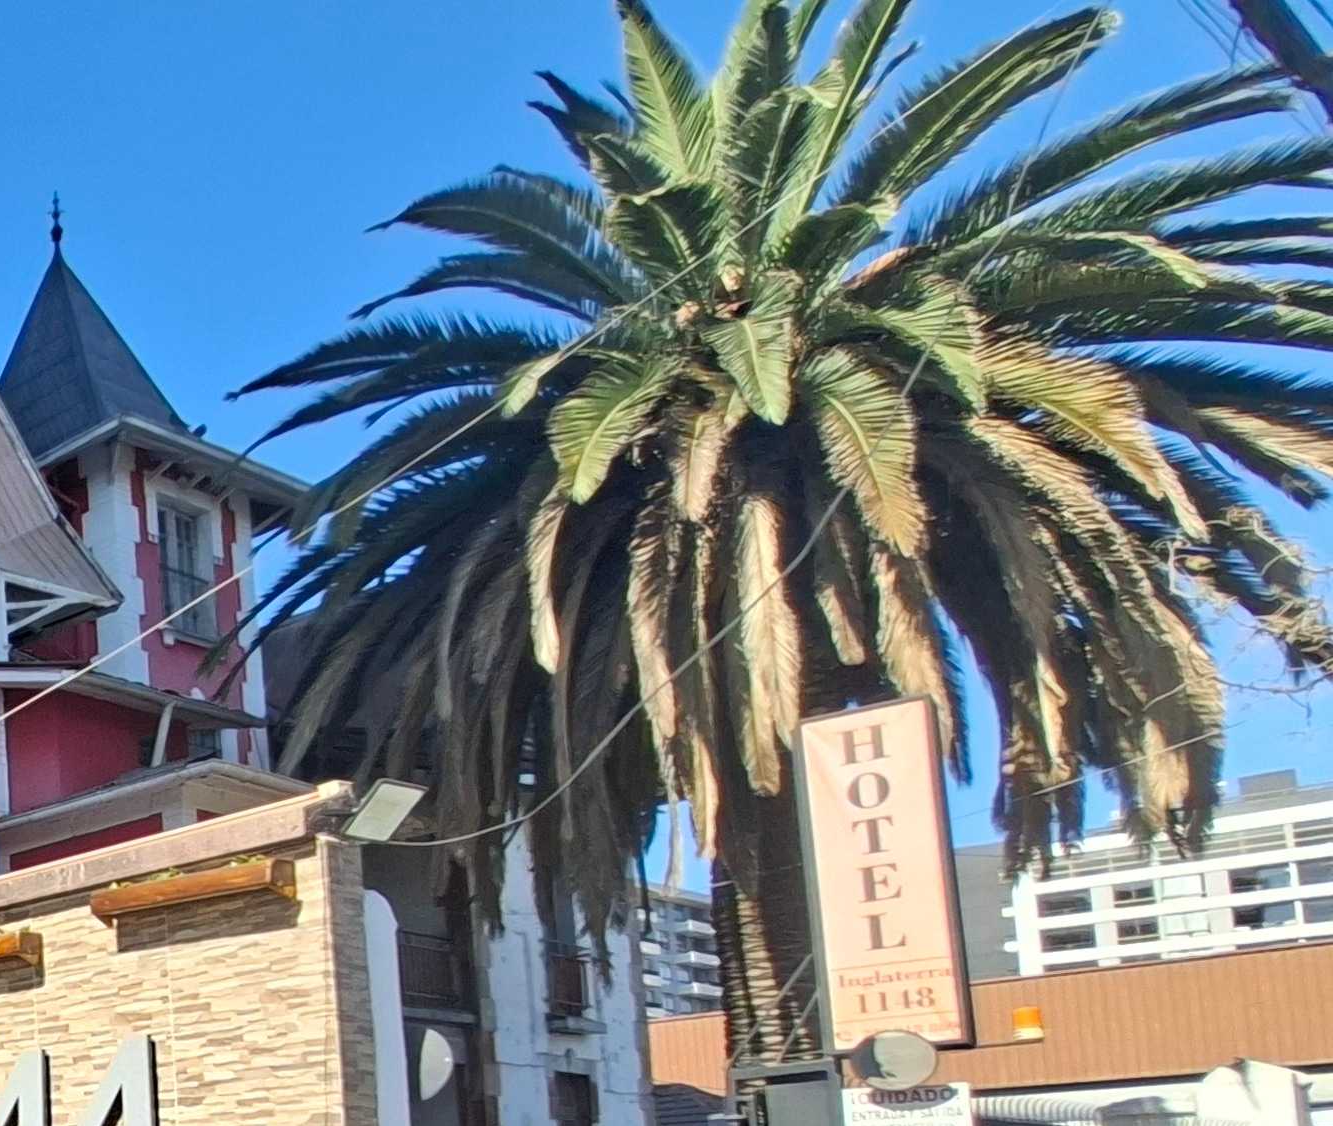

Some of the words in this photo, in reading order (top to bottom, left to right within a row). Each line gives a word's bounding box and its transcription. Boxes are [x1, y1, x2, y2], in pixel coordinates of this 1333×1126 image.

[840, 723, 908, 952] HOTEL
[837, 968, 952, 989] Inglaterra
[857, 986, 935, 1013] 1148
